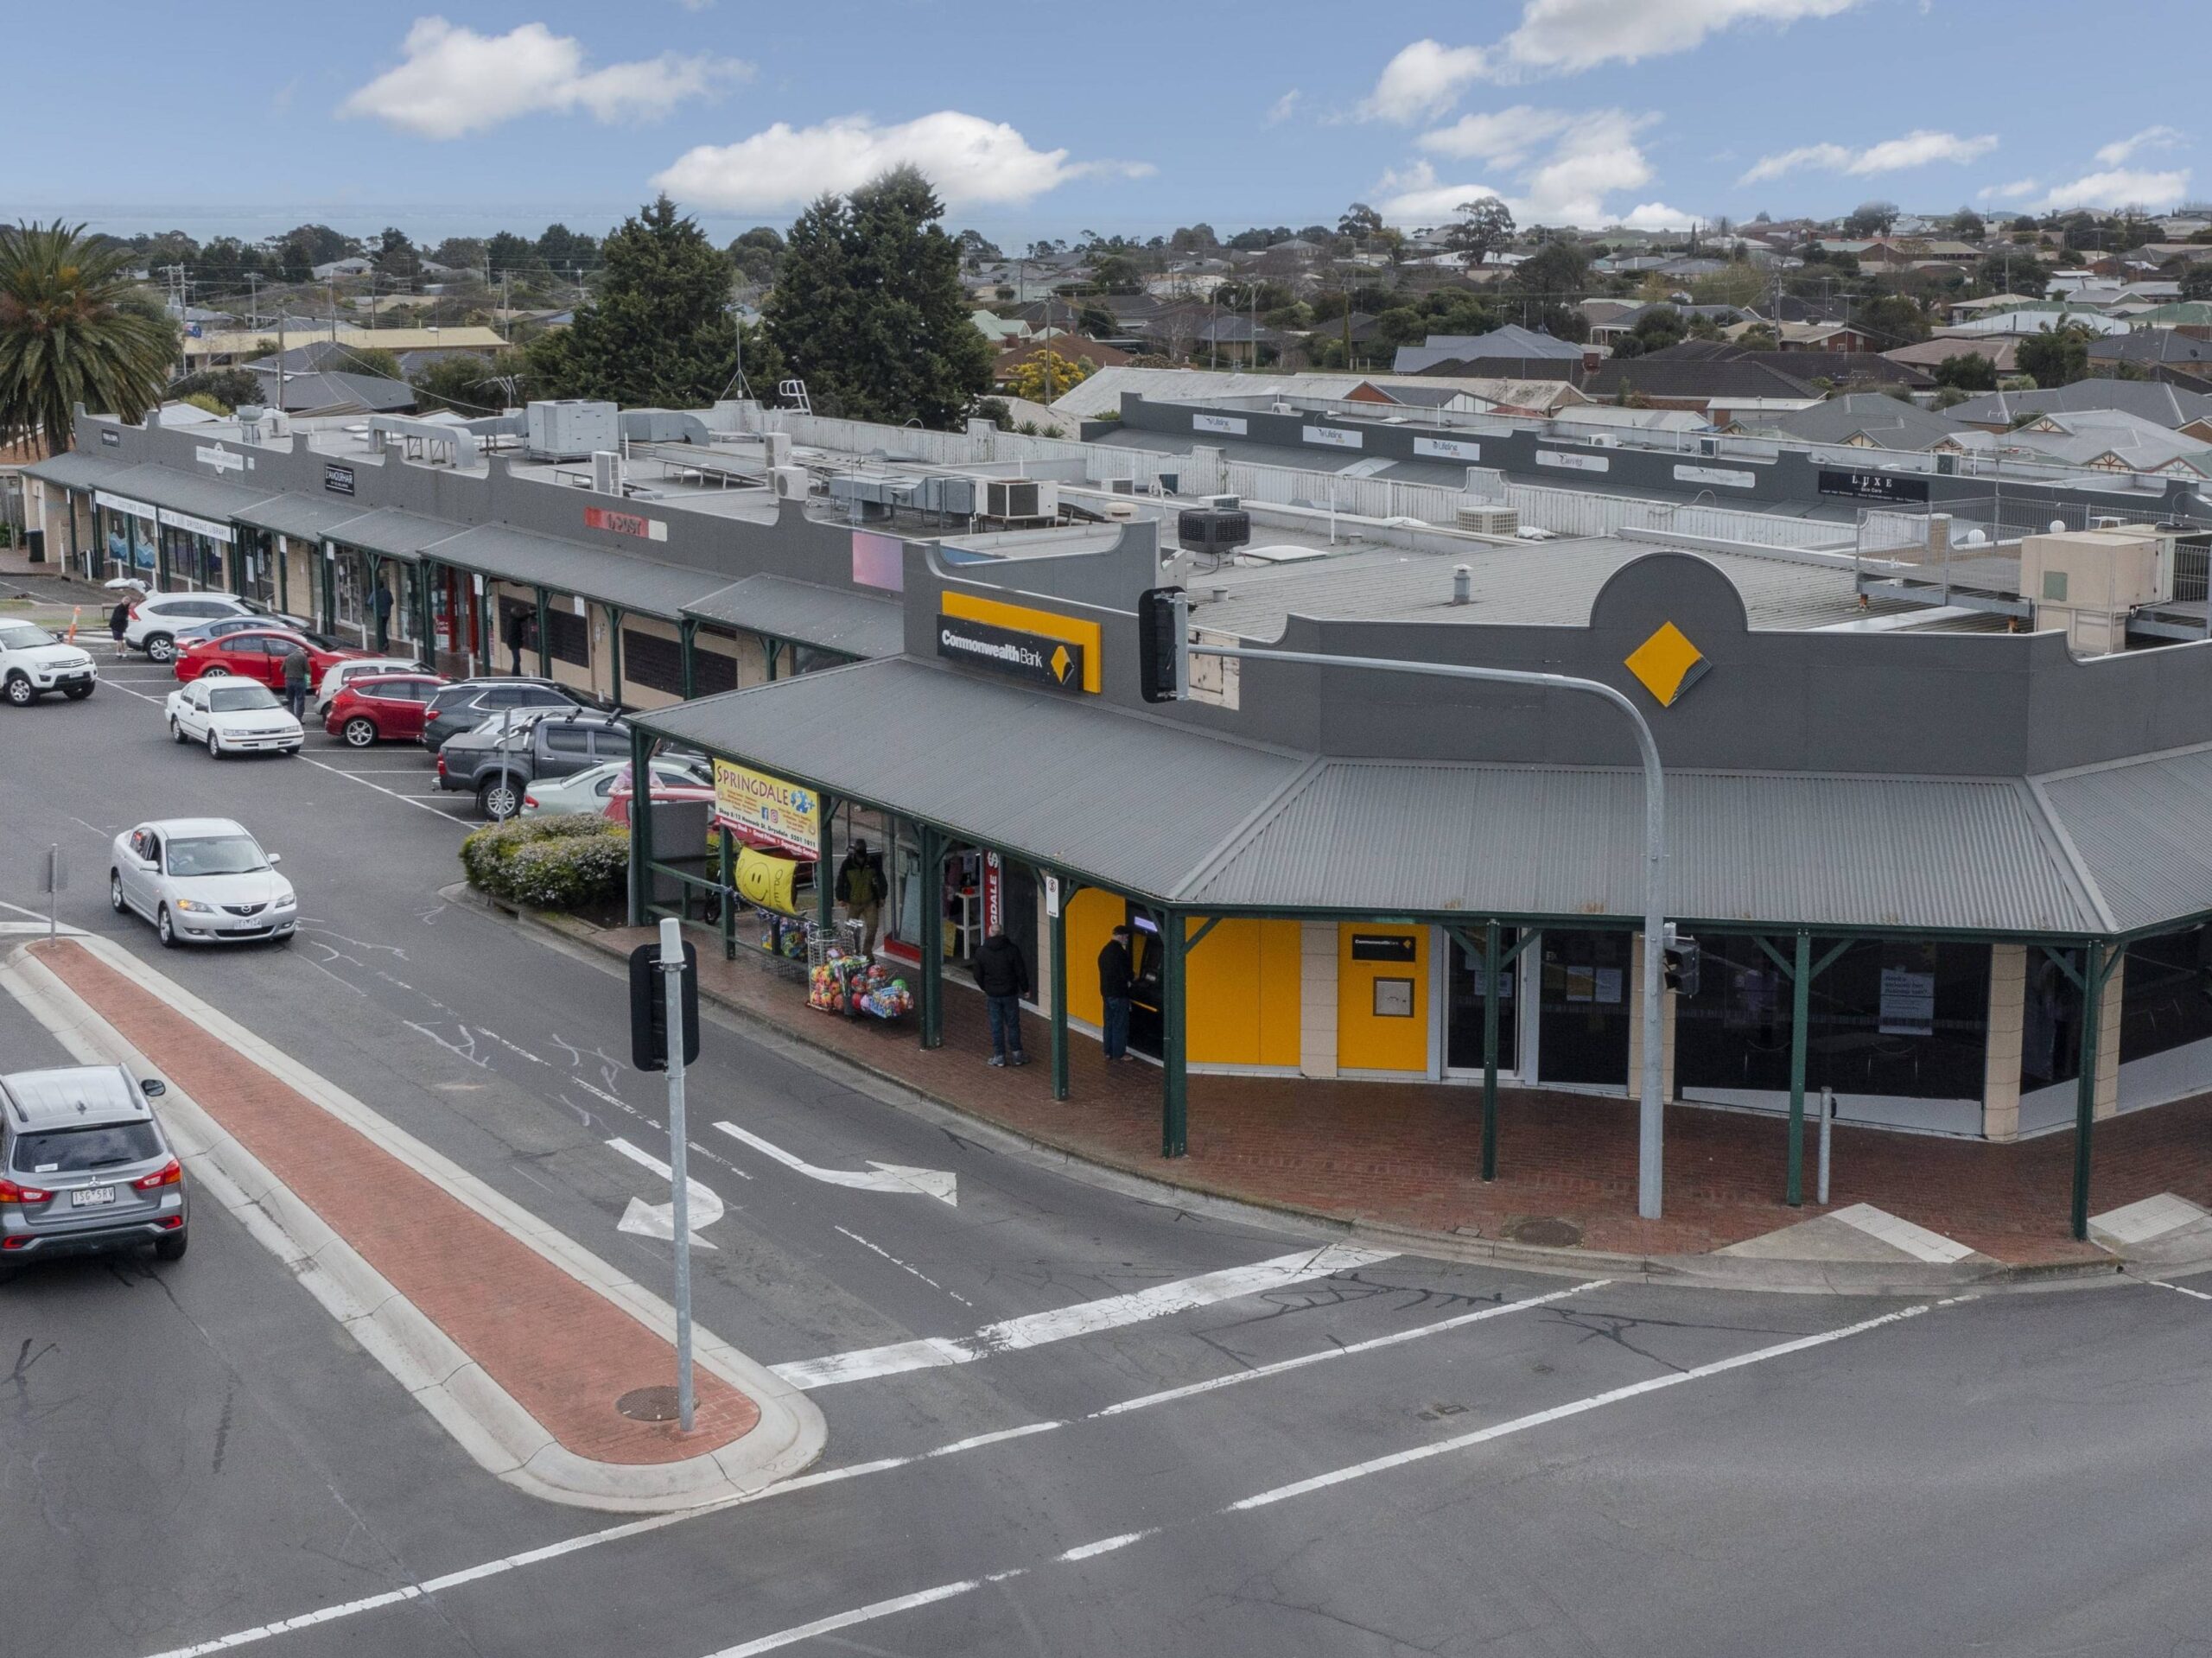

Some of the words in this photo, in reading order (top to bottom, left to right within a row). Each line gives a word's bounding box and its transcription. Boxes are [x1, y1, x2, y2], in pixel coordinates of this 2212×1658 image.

[1852, 474, 1892, 487] LUXE
[717, 765, 789, 805] SPRINGDALE
[719, 808, 729, 816] Shop
[768, 826, 788, 837] Drysdale
